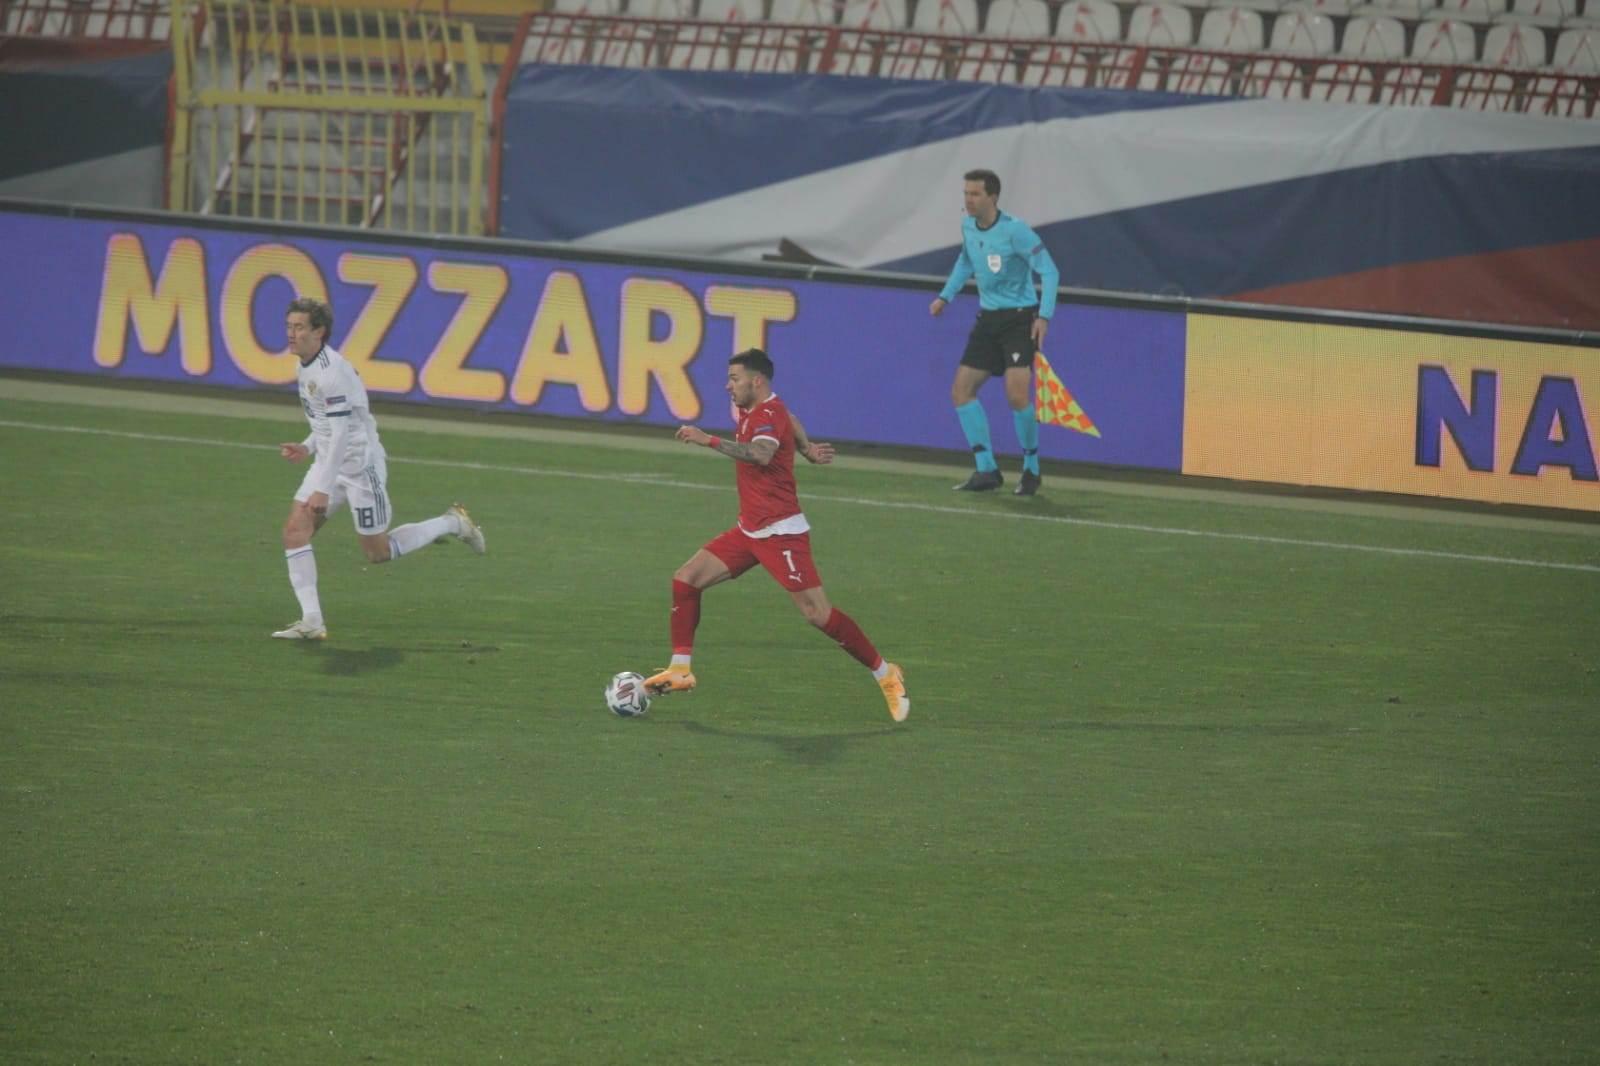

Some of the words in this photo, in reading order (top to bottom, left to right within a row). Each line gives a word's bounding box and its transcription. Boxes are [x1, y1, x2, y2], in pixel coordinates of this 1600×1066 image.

[93, 234, 796, 421] MOZZART
[1415, 364, 1600, 482] NA
[355, 506, 375, 528] 18
